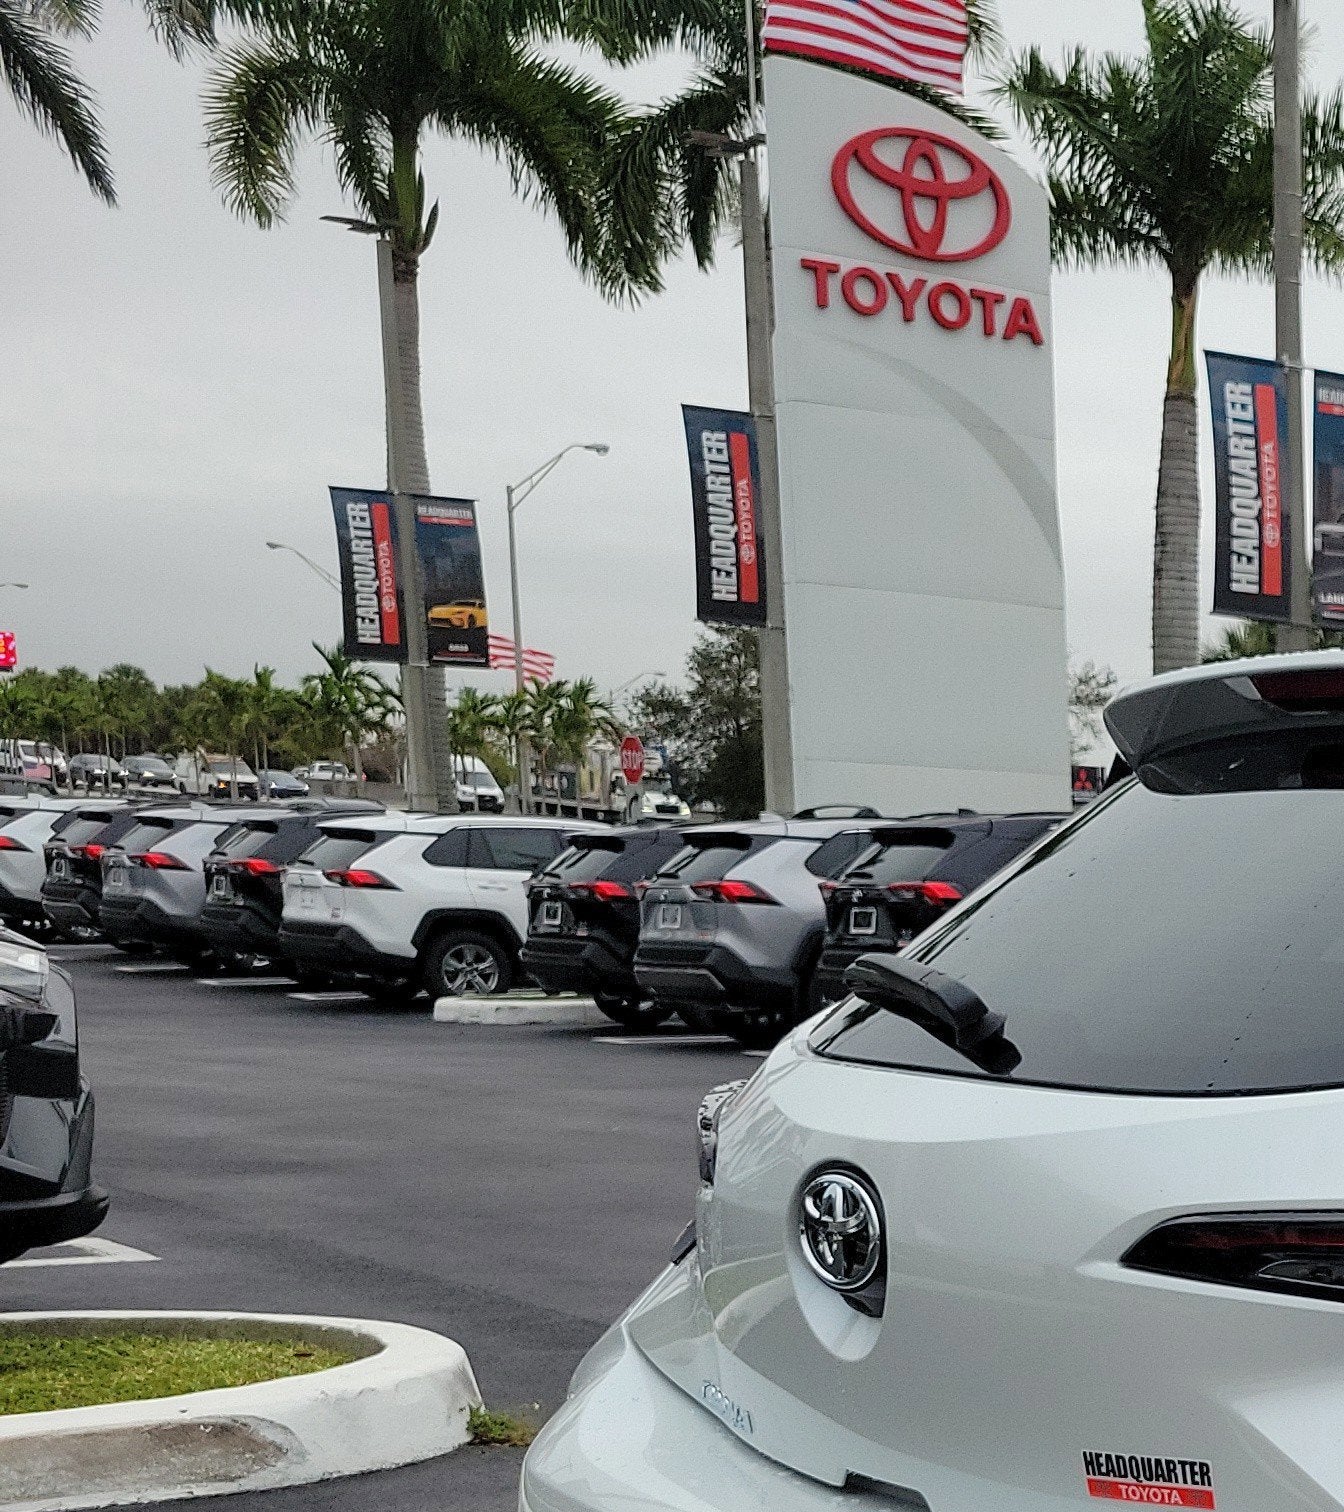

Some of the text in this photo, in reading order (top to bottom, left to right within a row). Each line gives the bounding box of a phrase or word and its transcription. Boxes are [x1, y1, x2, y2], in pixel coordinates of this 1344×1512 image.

[800, 258, 1044, 346] TOYOTA
[702, 429, 738, 602] HEADQUARTER
[737, 479, 754, 543] TOYOTA
[1224, 381, 1262, 595] HEADQUARTER
[1262, 441, 1278, 520] TOYOTA
[346, 502, 381, 644] HEADQUARTER
[378, 540, 395, 595] TOYOTA
[622, 749, 644, 770] STOP
[1082, 1450, 1213, 1488] HEADQUARTER
[1118, 1484, 1184, 1505] TOYOTA
